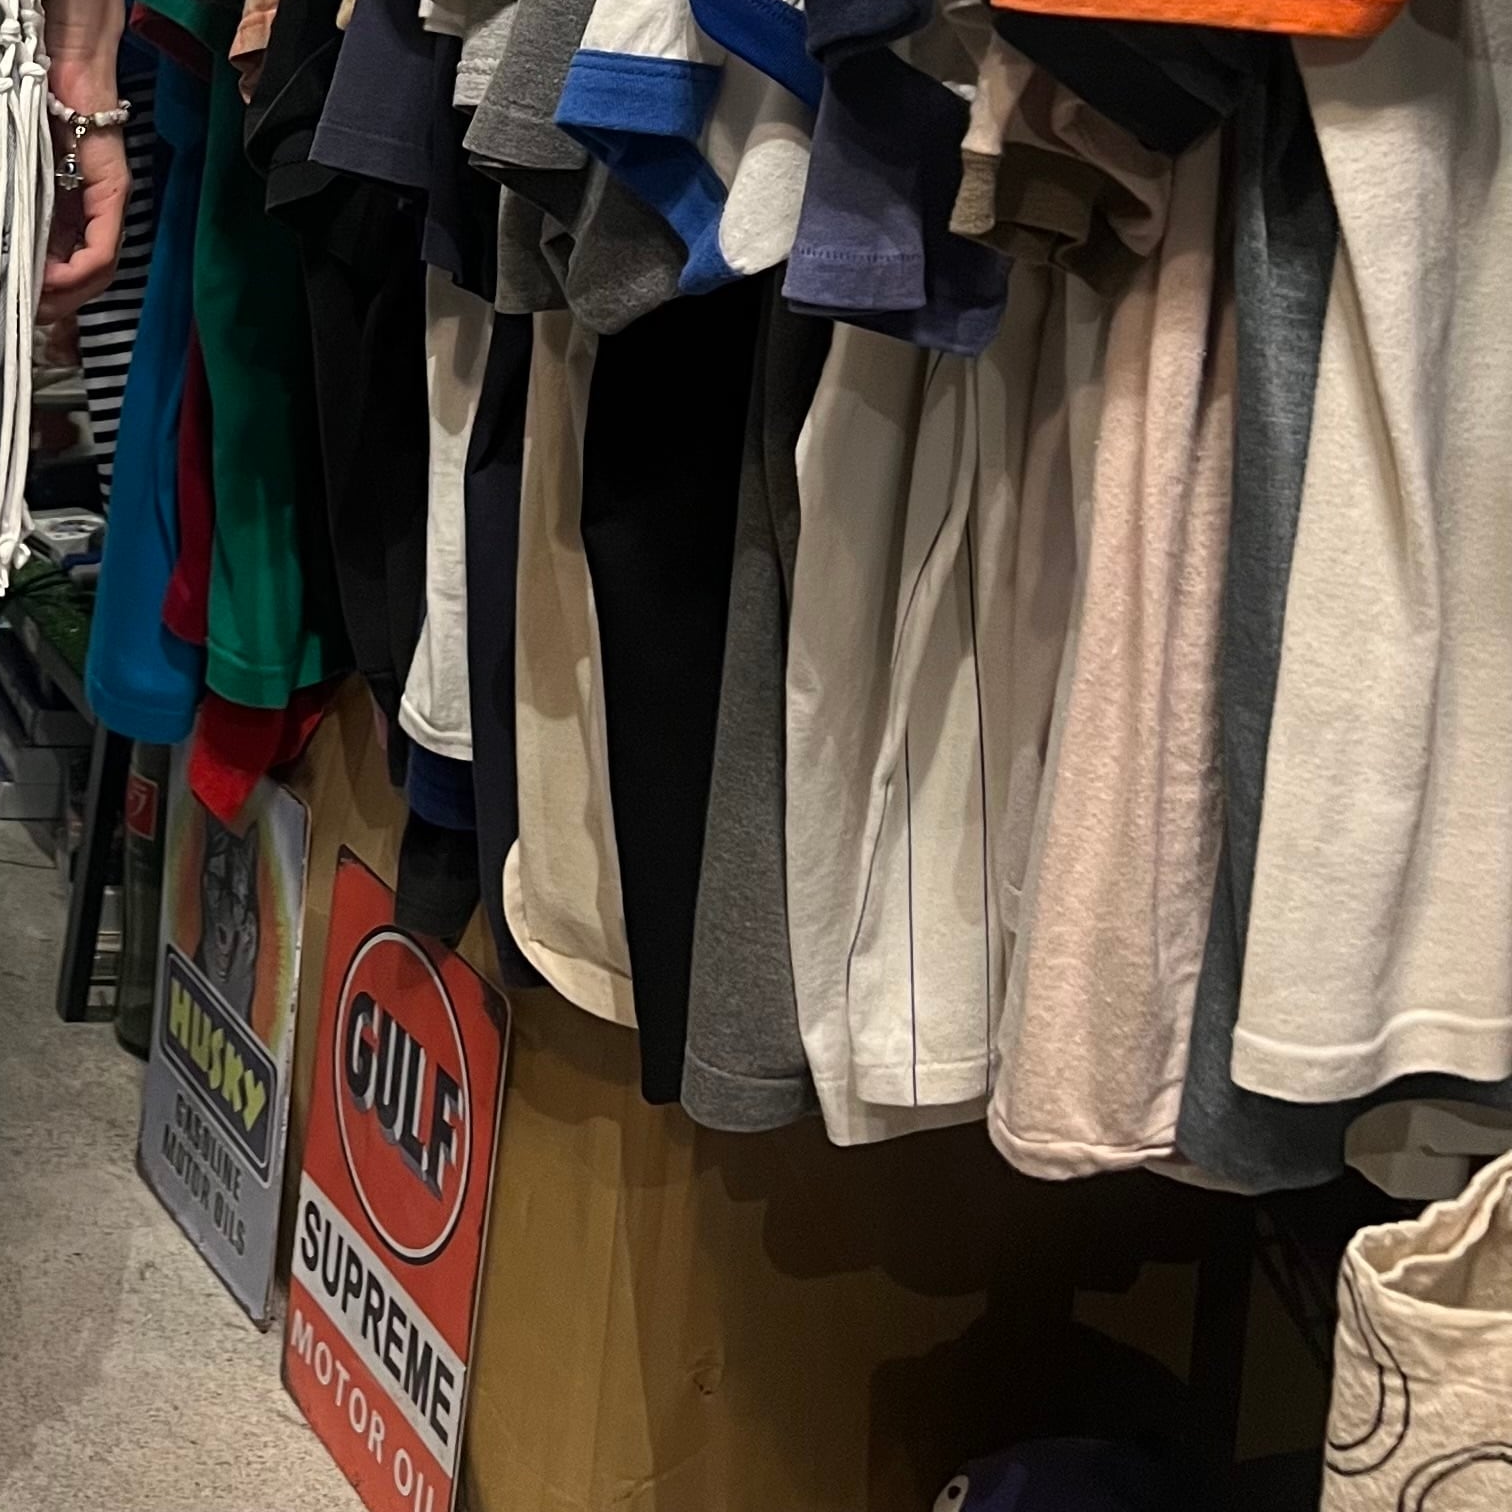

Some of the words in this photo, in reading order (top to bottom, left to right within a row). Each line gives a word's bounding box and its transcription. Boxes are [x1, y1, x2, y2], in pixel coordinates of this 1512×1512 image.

[169, 975, 267, 1132] HUSKY
[345, 990, 466, 1200] GULF
[162, 1122, 211, 1212] MOTOR
[212, 1190, 246, 1257] OILS
[175, 1088, 241, 1202] GASOLINE
[289, 1309, 386, 1465] MOTOR
[300, 1200, 455, 1447] SUPREME
